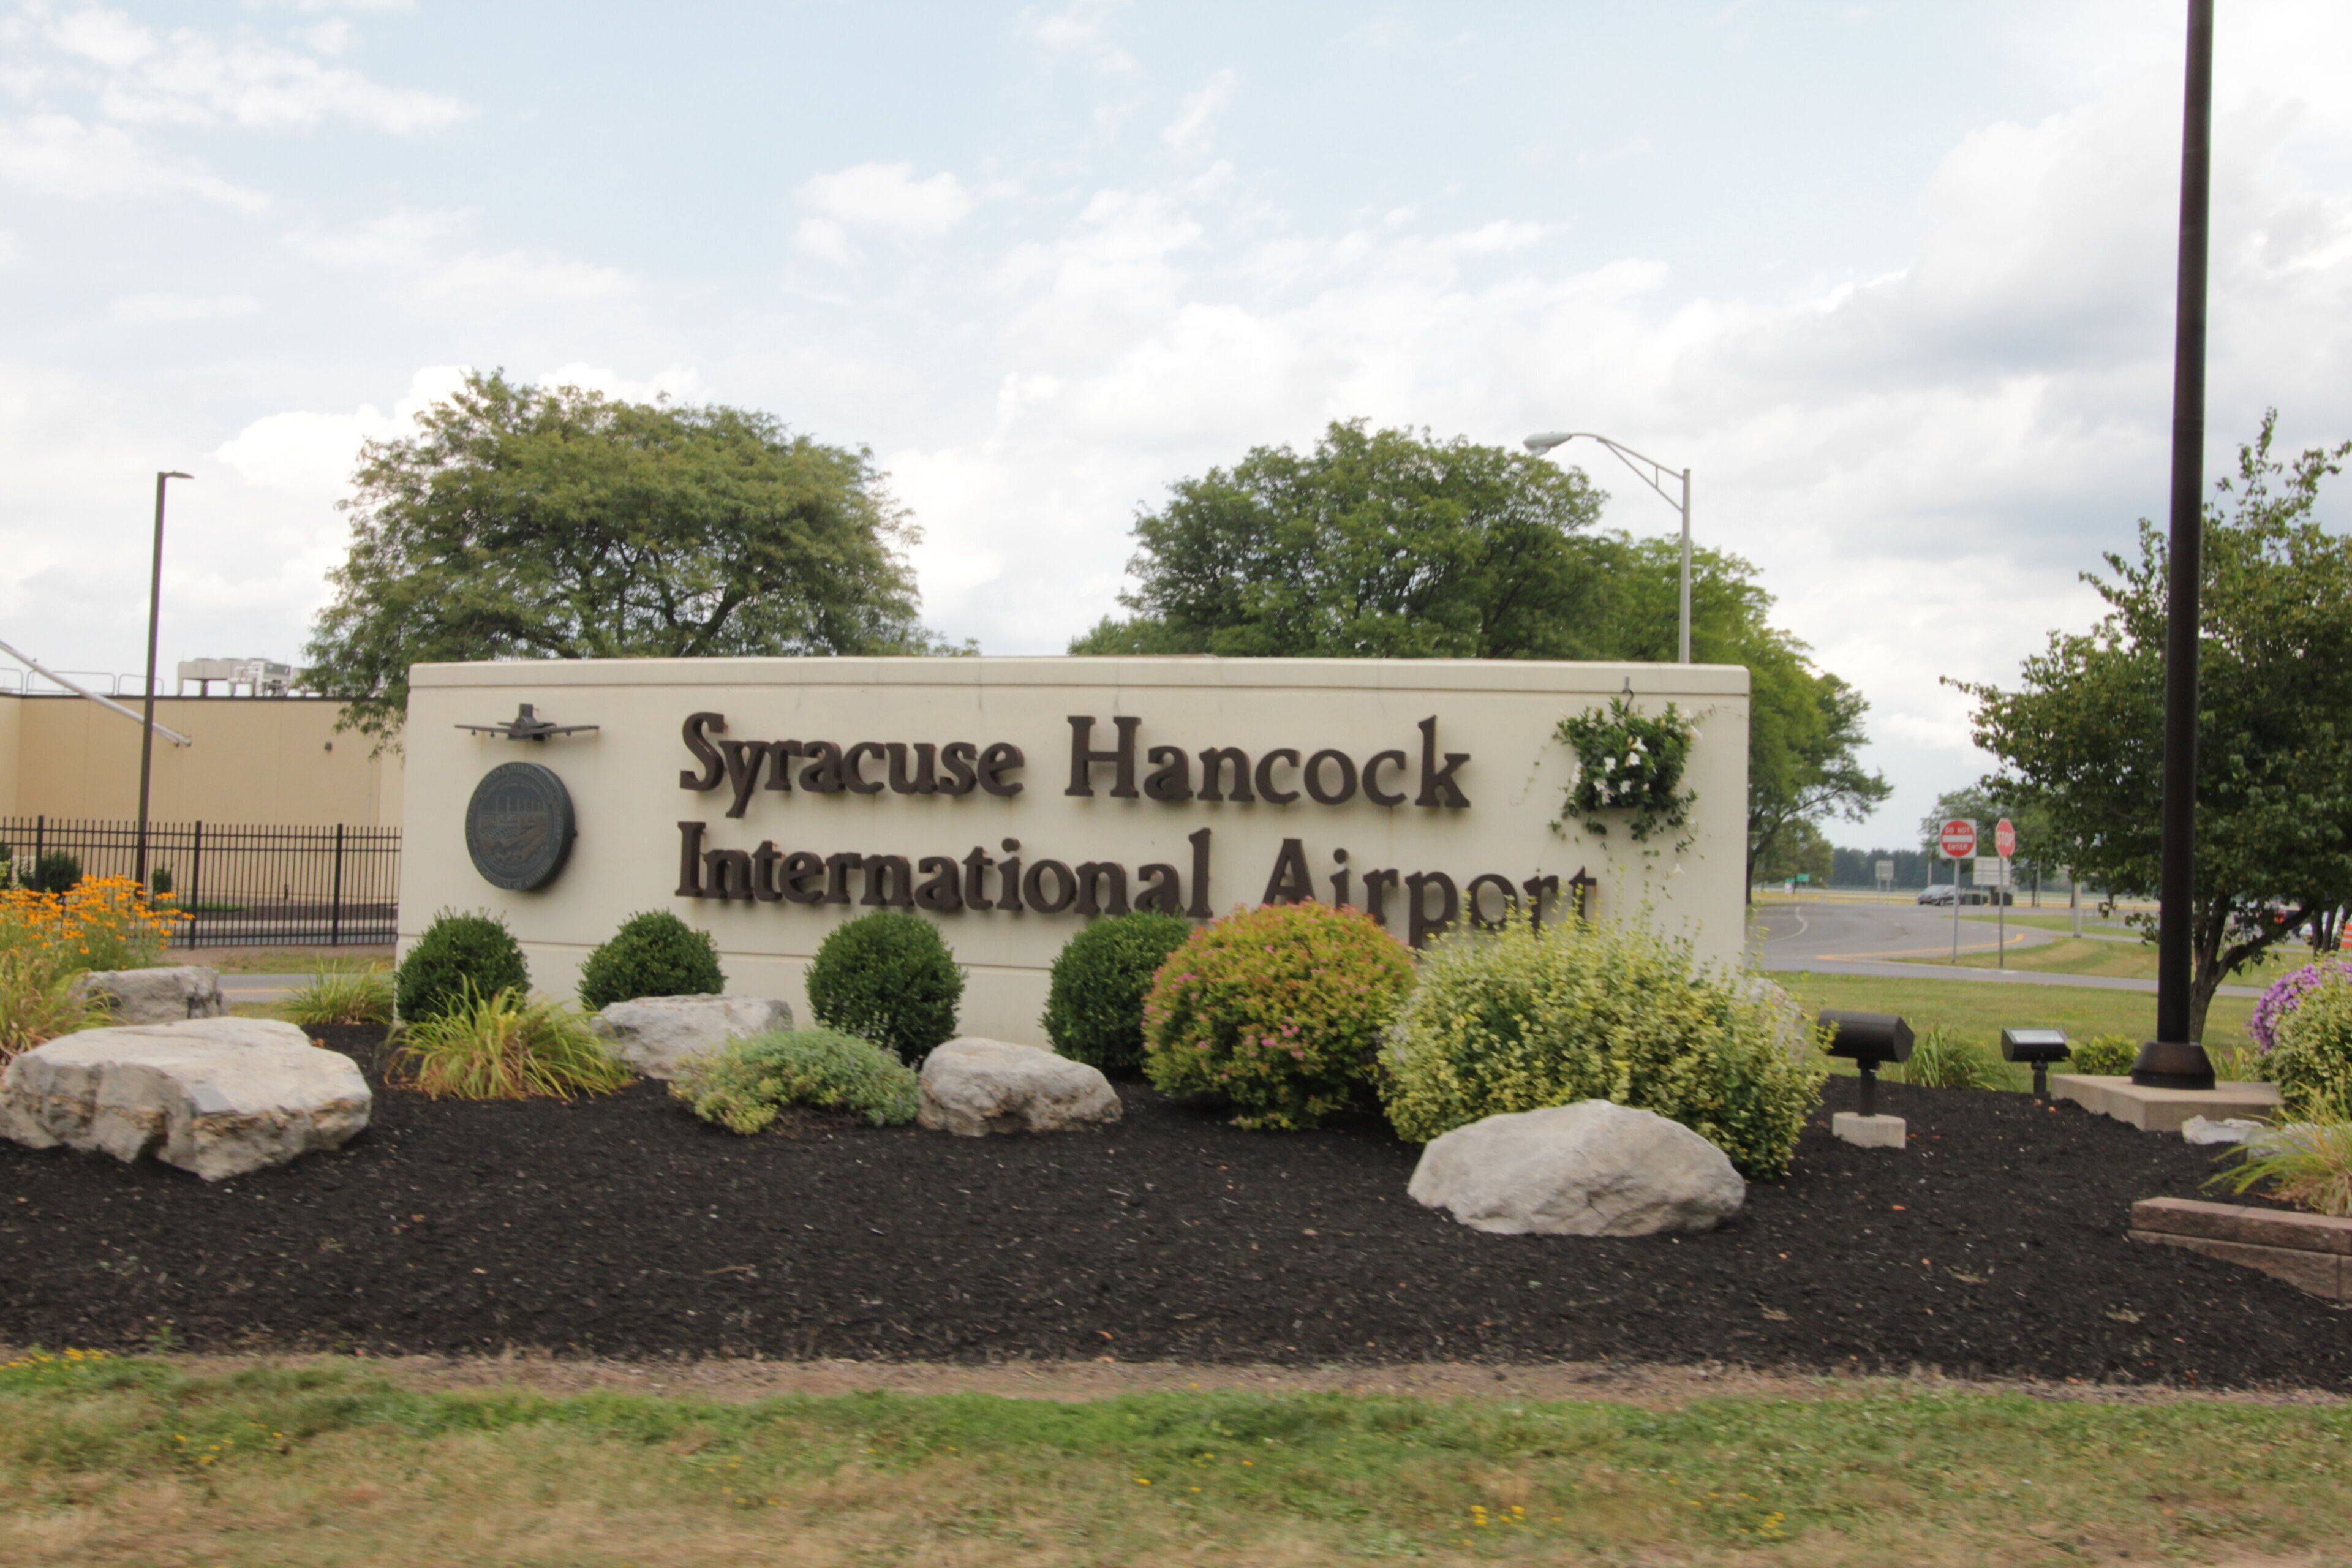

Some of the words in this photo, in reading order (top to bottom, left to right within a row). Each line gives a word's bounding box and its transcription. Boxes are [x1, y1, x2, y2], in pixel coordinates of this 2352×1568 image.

[680, 712, 1025, 818] Syracuse
[1065, 714, 1471, 808] Hancock
[675, 821, 1213, 918] International
[1262, 839, 1597, 949] Airport
[1997, 831, 2014, 846] STOP
